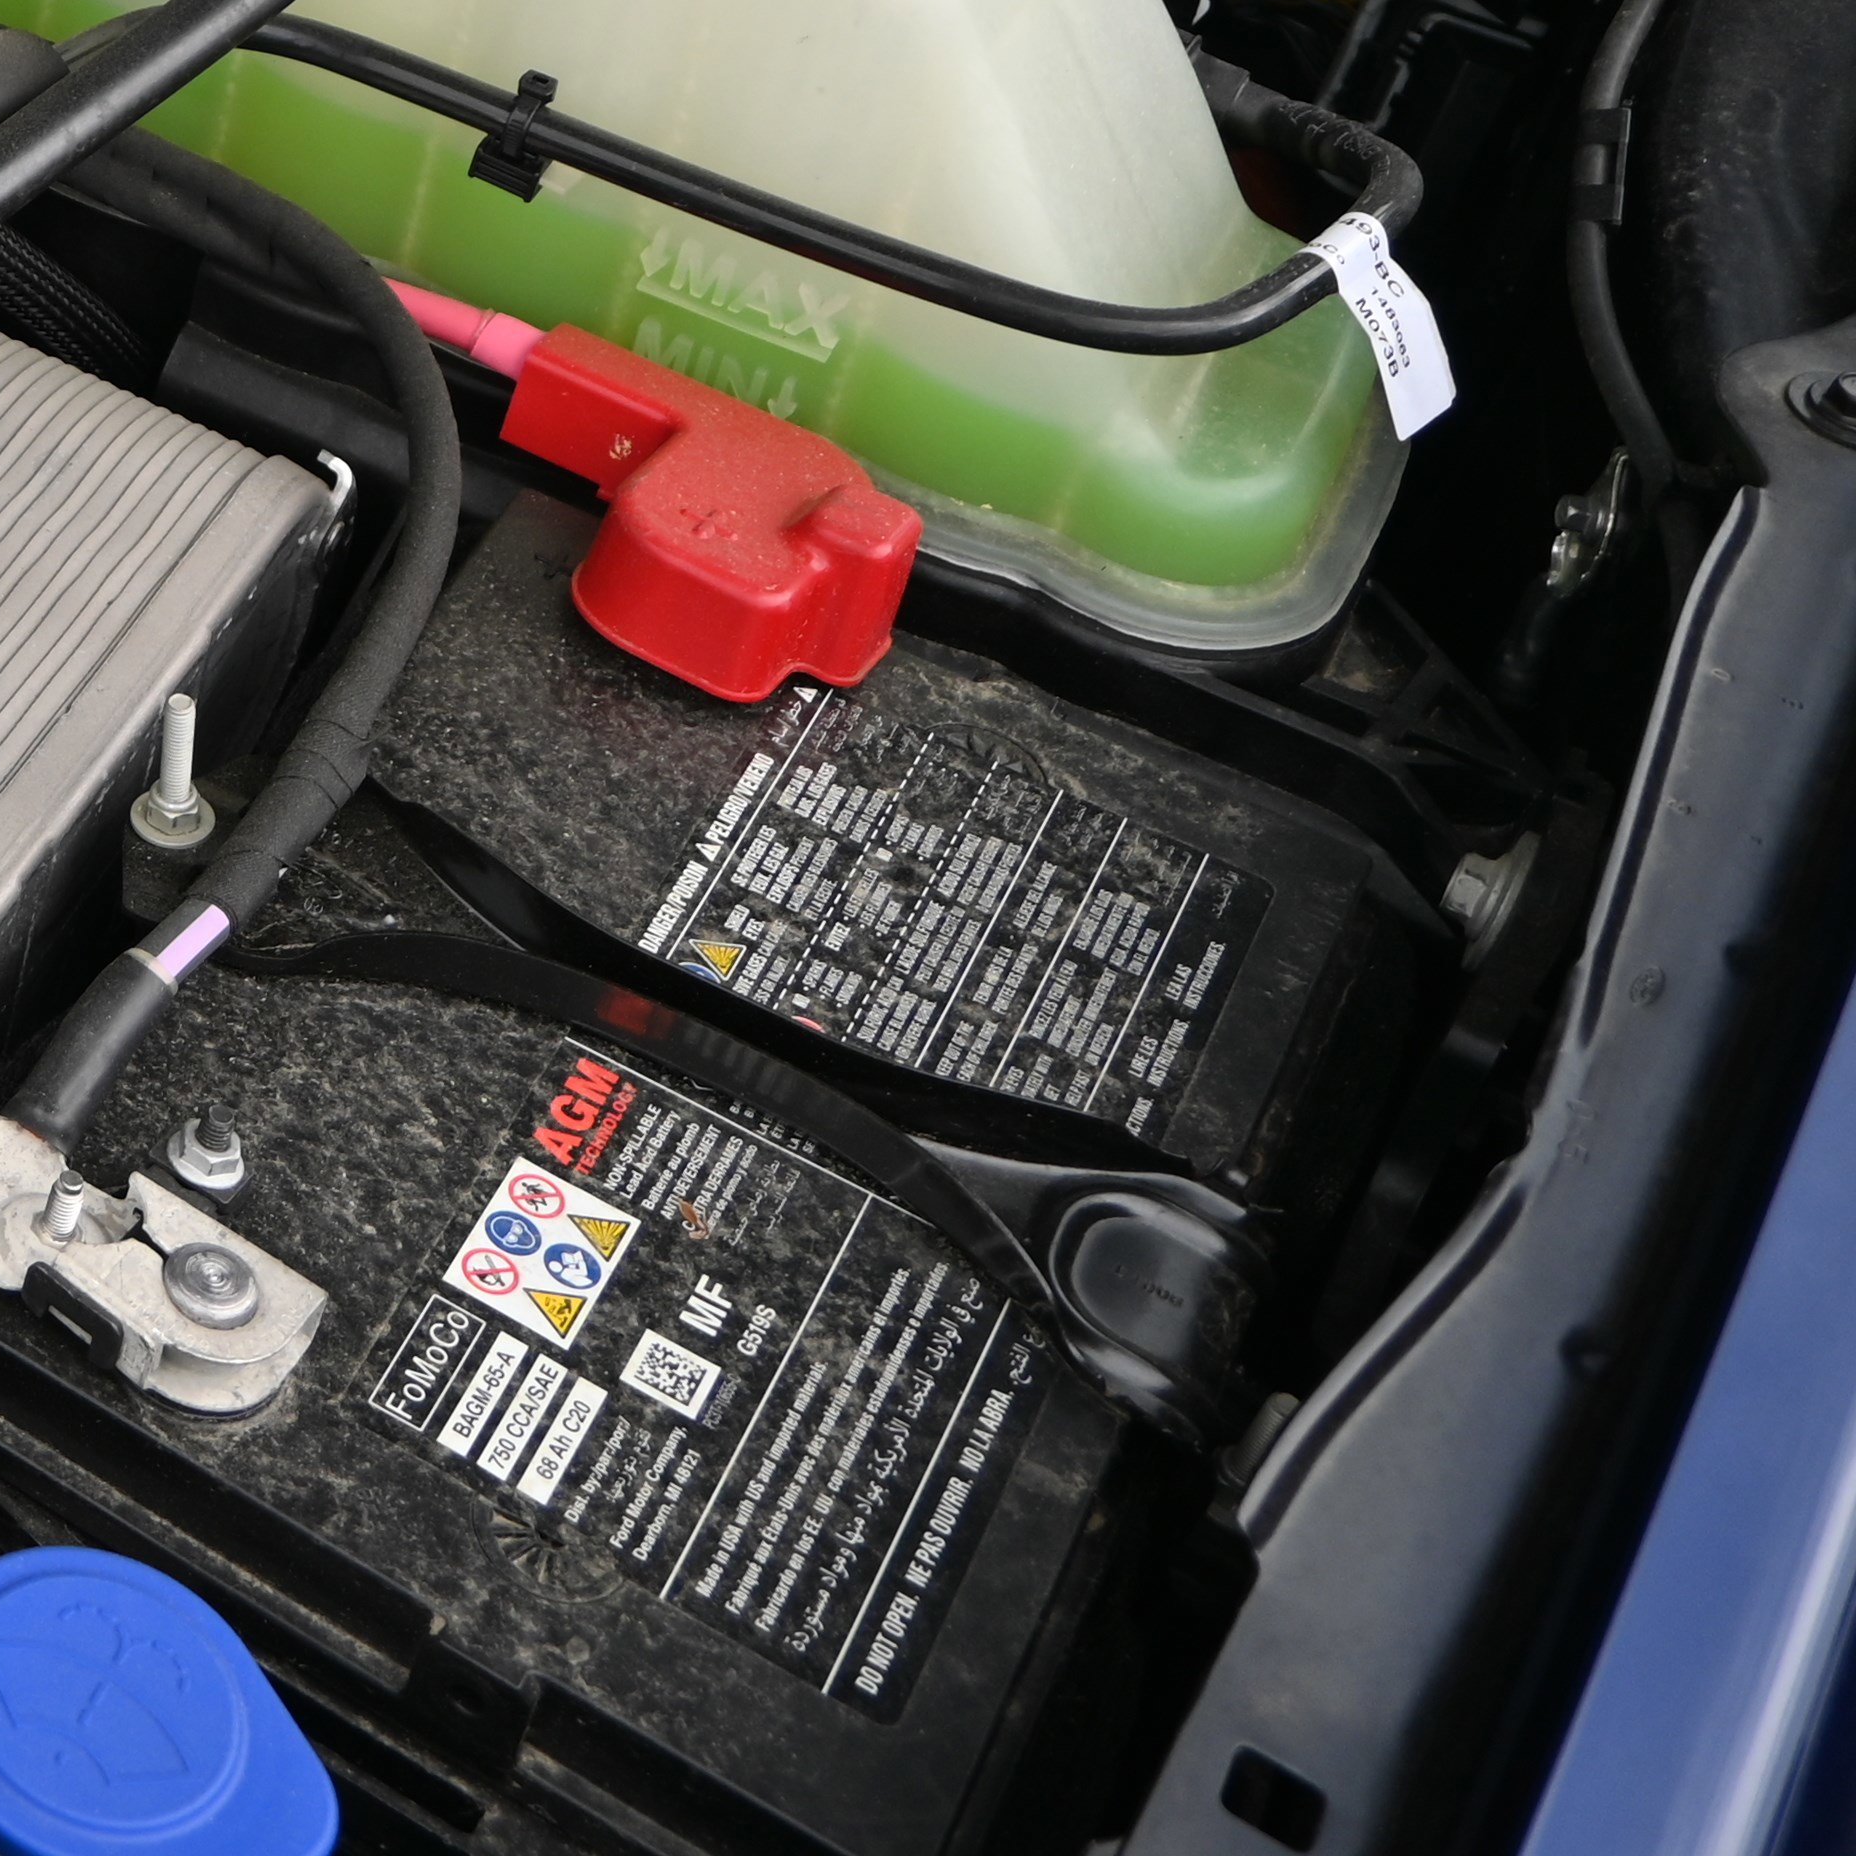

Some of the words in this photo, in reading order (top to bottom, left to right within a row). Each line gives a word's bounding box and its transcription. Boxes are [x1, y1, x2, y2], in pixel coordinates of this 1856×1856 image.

[668, 238, 851, 350] MAX
[635, 859, 710, 954] DANGER/POISON
[703, 751, 777, 845] PELIGRO/VENENO
[729, 872, 749, 887] SE
[756, 824, 777, 841] LES
[760, 856, 781, 873] LES
[768, 841, 790, 860] GAZ
[740, 916, 767, 940] EYES.
[1163, 980, 1184, 1001] LEA
[1171, 962, 1193, 984] LAS
[1181, 937, 1227, 1010] INSTRUCCIONES.
[1137, 1034, 1159, 1056] LES
[1145, 1015, 1191, 1087] INSTRUCTIONS.
[1126, 1052, 1151, 1078] LIRE
[527, 1055, 621, 1165] AGM
[574, 1080, 639, 1175] TECHNOLOGY
[602, 1103, 661, 1191] NON-SPILLABLE
[620, 1170, 645, 1200] Lead
[634, 1145, 658, 1172] Acid
[648, 1108, 682, 1150] Battery
[672, 1120, 703, 1157] plomb
[666, 1154, 682, 1170] au
[735, 1166, 748, 1176] y
[640, 1167, 674, 1211] Batterie
[680, 1187, 715, 1232] CTRA
[703, 1134, 744, 1191] DERRAMES
[720, 1171, 743, 1200] plomo
[714, 1197, 728, 1211] de
[677, 1272, 739, 1338] MF
[910, 1257, 952, 1321] importados.
[734, 1301, 778, 1358] G519S
[872, 1311, 888, 1327] et
[908, 1317, 922, 1328] e
[384, 1303, 471, 1422] FoMoCo
[864, 1324, 917, 1414] estadounidenses
[451, 1347, 515, 1439] BAGM-65-A
[789, 1355, 829, 1413] materials.
[487, 1435, 517, 1470] 750
[503, 1361, 559, 1440] CCA/SAE
[560, 1398, 592, 1435] C20
[977, 1382, 1016, 1432] ABRA.
[547, 1430, 574, 1460] Ah
[764, 1407, 804, 1463] imported
[804, 1431, 827, 1457] des
[834, 1408, 876, 1471] materiales
[968, 1425, 996, 1452] LA
[535, 1455, 559, 1481] 68
[671, 1446, 701, 1485] 48121
[753, 1456, 777, 1484] and
[792, 1453, 816, 1484] avec
[958, 1443, 987, 1473] NO
[608, 1514, 636, 1549] Ford
[624, 1478, 655, 1519] Motor
[643, 1420, 689, 1485] Company,
[663, 1480, 683, 1502] MI
[744, 1477, 766, 1502] US
[827, 1467, 847, 1493] con
[563, 1489, 590, 1524] Dist.
[730, 1496, 756, 1527] with
[757, 1477, 803, 1543] États-Unis
[812, 1488, 836, 1516] UU.
[928, 1469, 975, 1537] OUVRIR.
[631, 1496, 675, 1562] Dearborn,
[718, 1521, 744, 1552] USA
[801, 1510, 825, 1536] EE.
[711, 1546, 731, 1565] in
[752, 1539, 773, 1564] aux
[787, 1551, 806, 1571] en
[792, 1530, 815, 1555] los
[914, 1528, 948, 1567] PAS
[694, 1559, 724, 1598] Made
[724, 1558, 766, 1617] Fabriqué
[903, 1558, 934, 1589] NE
[754, 1565, 798, 1633] Fabricardo
[880, 1584, 922, 1640] OPEN.
[865, 1630, 900, 1672] NOT
[854, 1662, 885, 1697] DO
